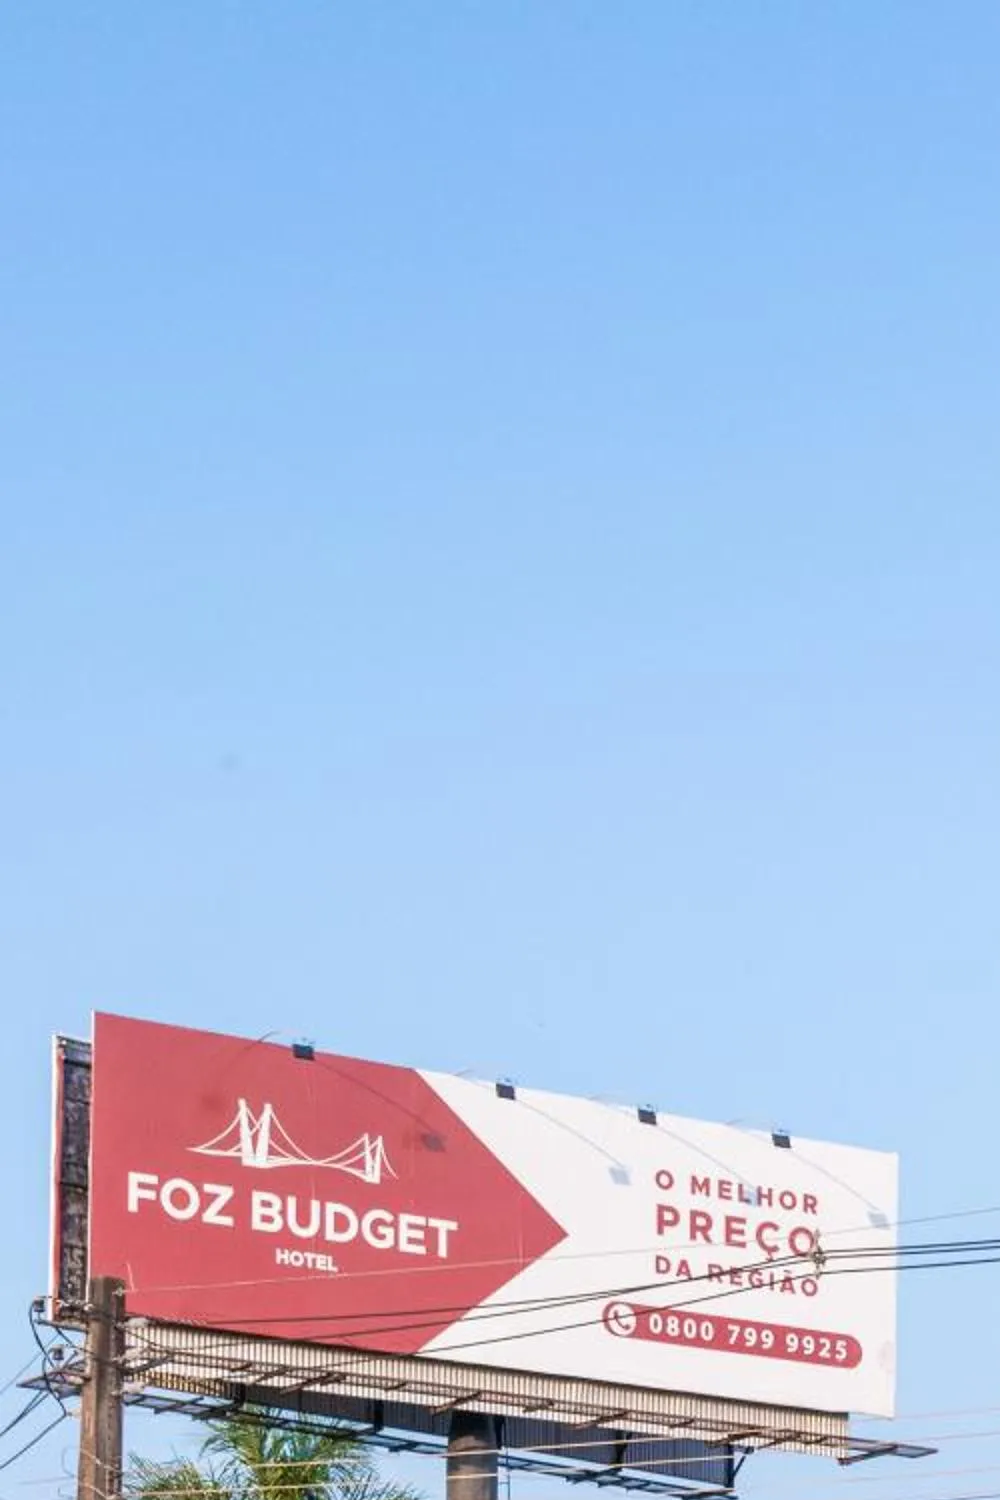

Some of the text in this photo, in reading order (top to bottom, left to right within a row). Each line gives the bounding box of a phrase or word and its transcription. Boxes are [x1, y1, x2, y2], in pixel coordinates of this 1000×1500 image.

[127, 1171, 458, 1258] FOZ BUDGET
[655, 1169, 818, 1214] O MELHOR
[656, 1204, 815, 1261] PREÇO
[275, 1248, 338, 1273] HOTEL
[655, 1255, 818, 1297] DA REGIÃO
[649, 1313, 848, 1360] 0800 799 9925
